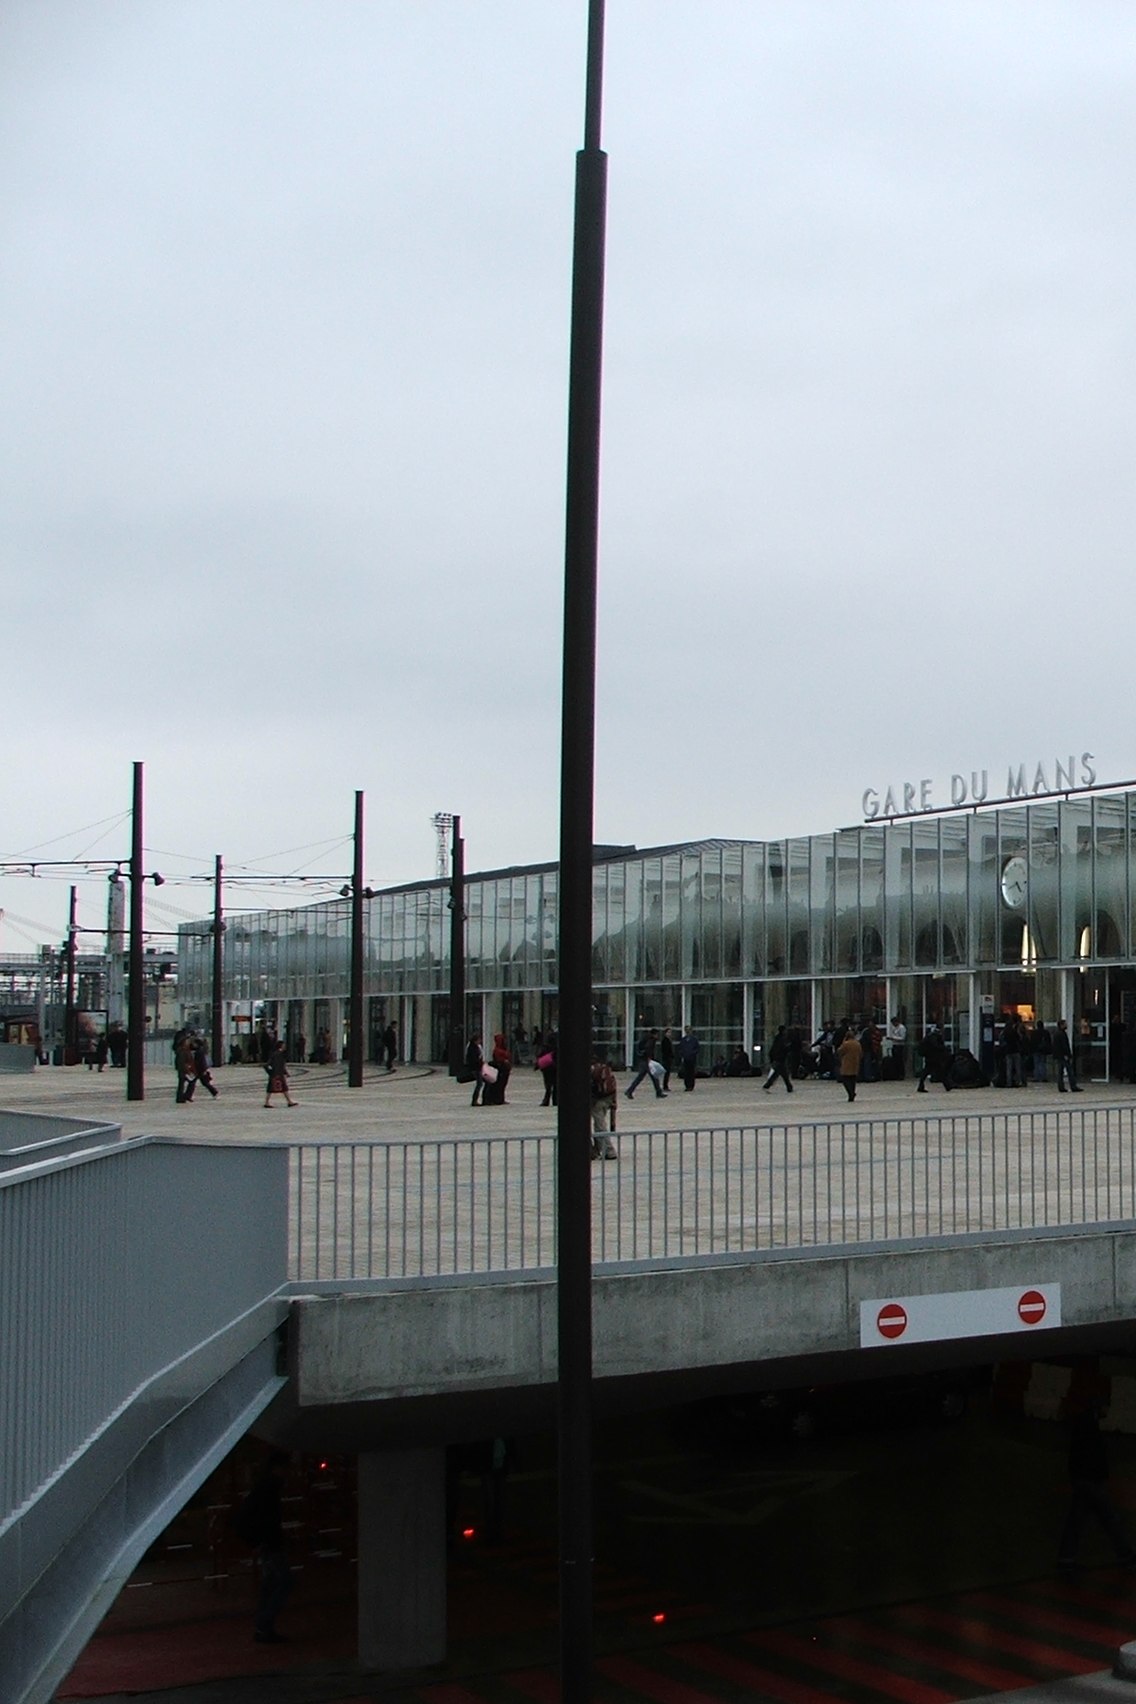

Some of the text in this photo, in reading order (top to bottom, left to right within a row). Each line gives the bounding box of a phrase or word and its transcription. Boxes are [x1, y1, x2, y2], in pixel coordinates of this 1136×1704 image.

[862, 751, 1097, 819] GARE DU MANS
